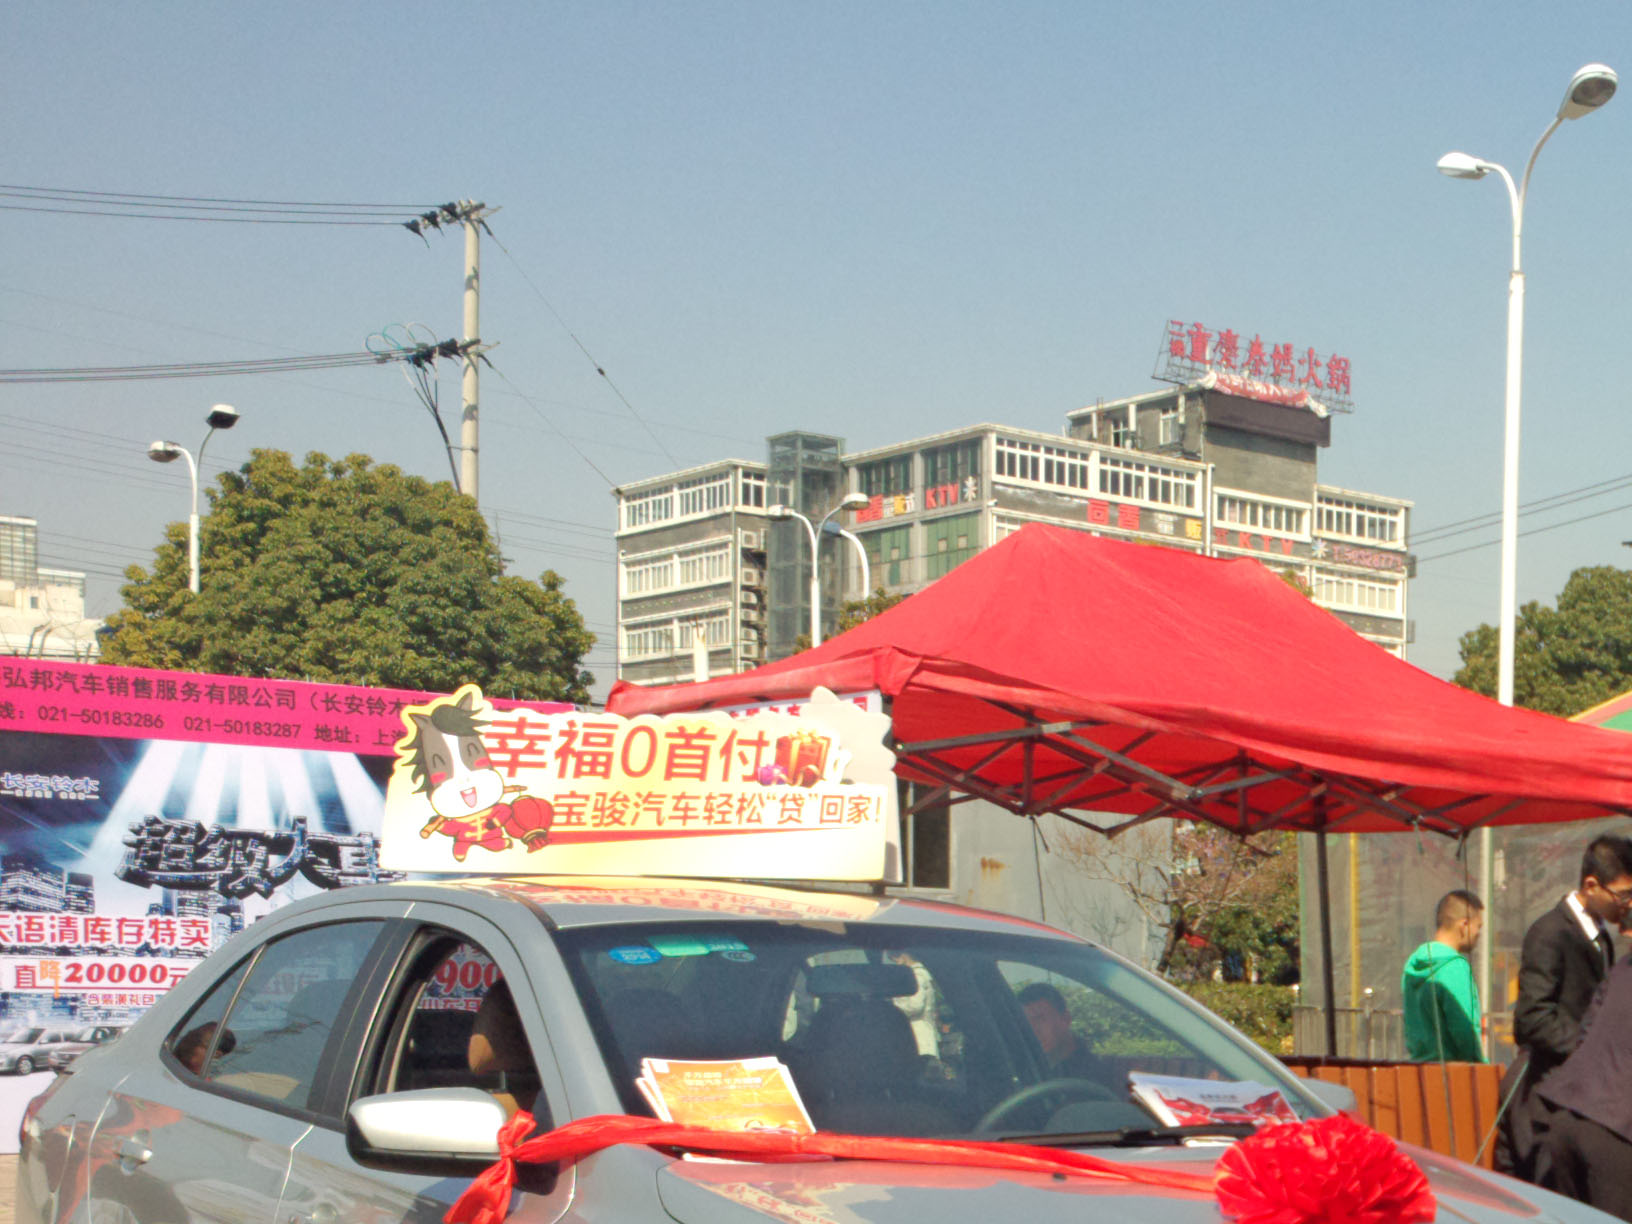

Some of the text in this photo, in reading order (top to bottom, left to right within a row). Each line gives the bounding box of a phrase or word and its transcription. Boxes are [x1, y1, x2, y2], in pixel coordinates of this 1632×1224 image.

[926, 483, 959, 510] KTV
[1239, 532, 1294, 556] KTV
[484, 716, 770, 783] 幸福0首付
